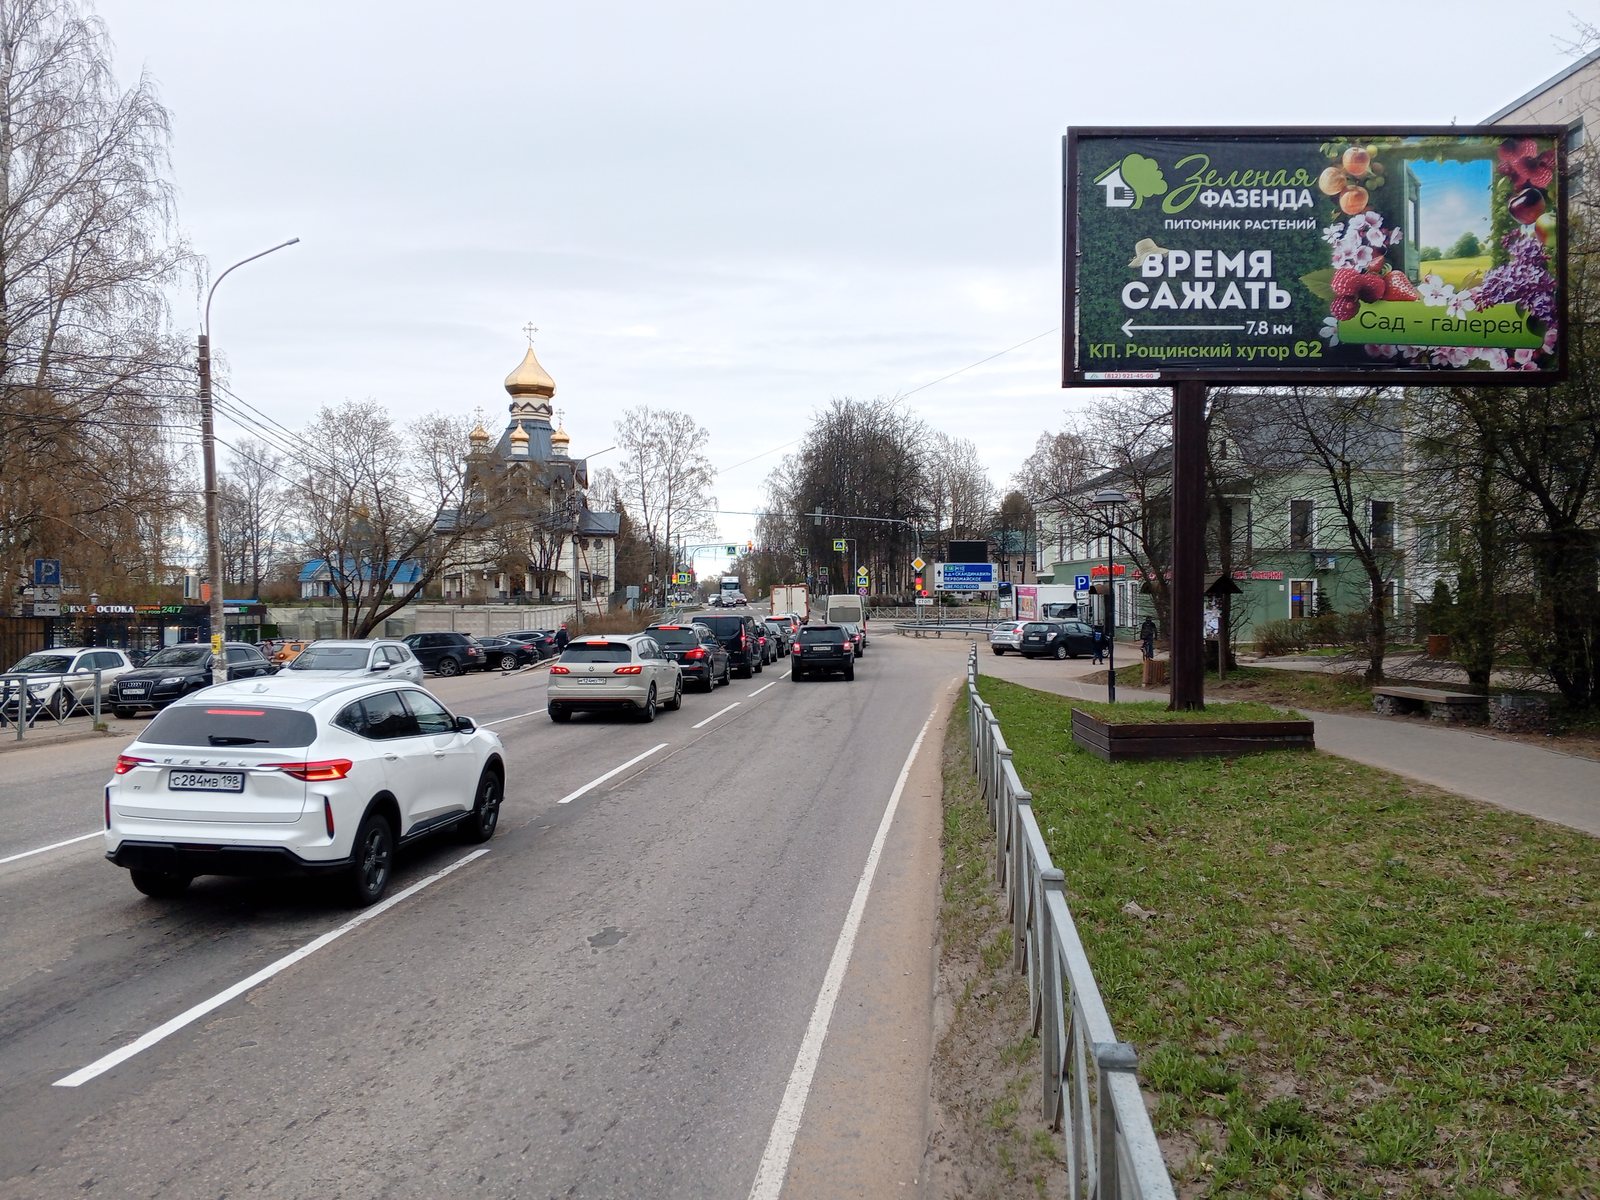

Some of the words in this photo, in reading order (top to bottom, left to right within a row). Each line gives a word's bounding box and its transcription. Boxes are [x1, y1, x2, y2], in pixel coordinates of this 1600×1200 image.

[1162, 153, 1319, 214] Зеленая
[1199, 188, 1314, 210] ФАЗЕНДА
[1164, 219, 1240, 230] ПИТОМНИК
[1245, 216, 1317, 230] РАСТЕНИЙ
[1141, 250, 1272, 278] ВРЕМЯ
[1121, 281, 1292, 310] САЖАТЬ
[1246, 321, 1269, 336] 7,8
[1273, 323, 1293, 336] км
[1360, 311, 1406, 333] Сад
[1431, 317, 1523, 339] галерея
[1090, 344, 1121, 358] КП.
[1125, 343, 1232, 360] Рощинский
[1236, 345, 1290, 361] хутор
[1294, 341, 1323, 358] 62
[163, 757, 247, 767] HAVAL
[220, 775, 239, 785] 198
